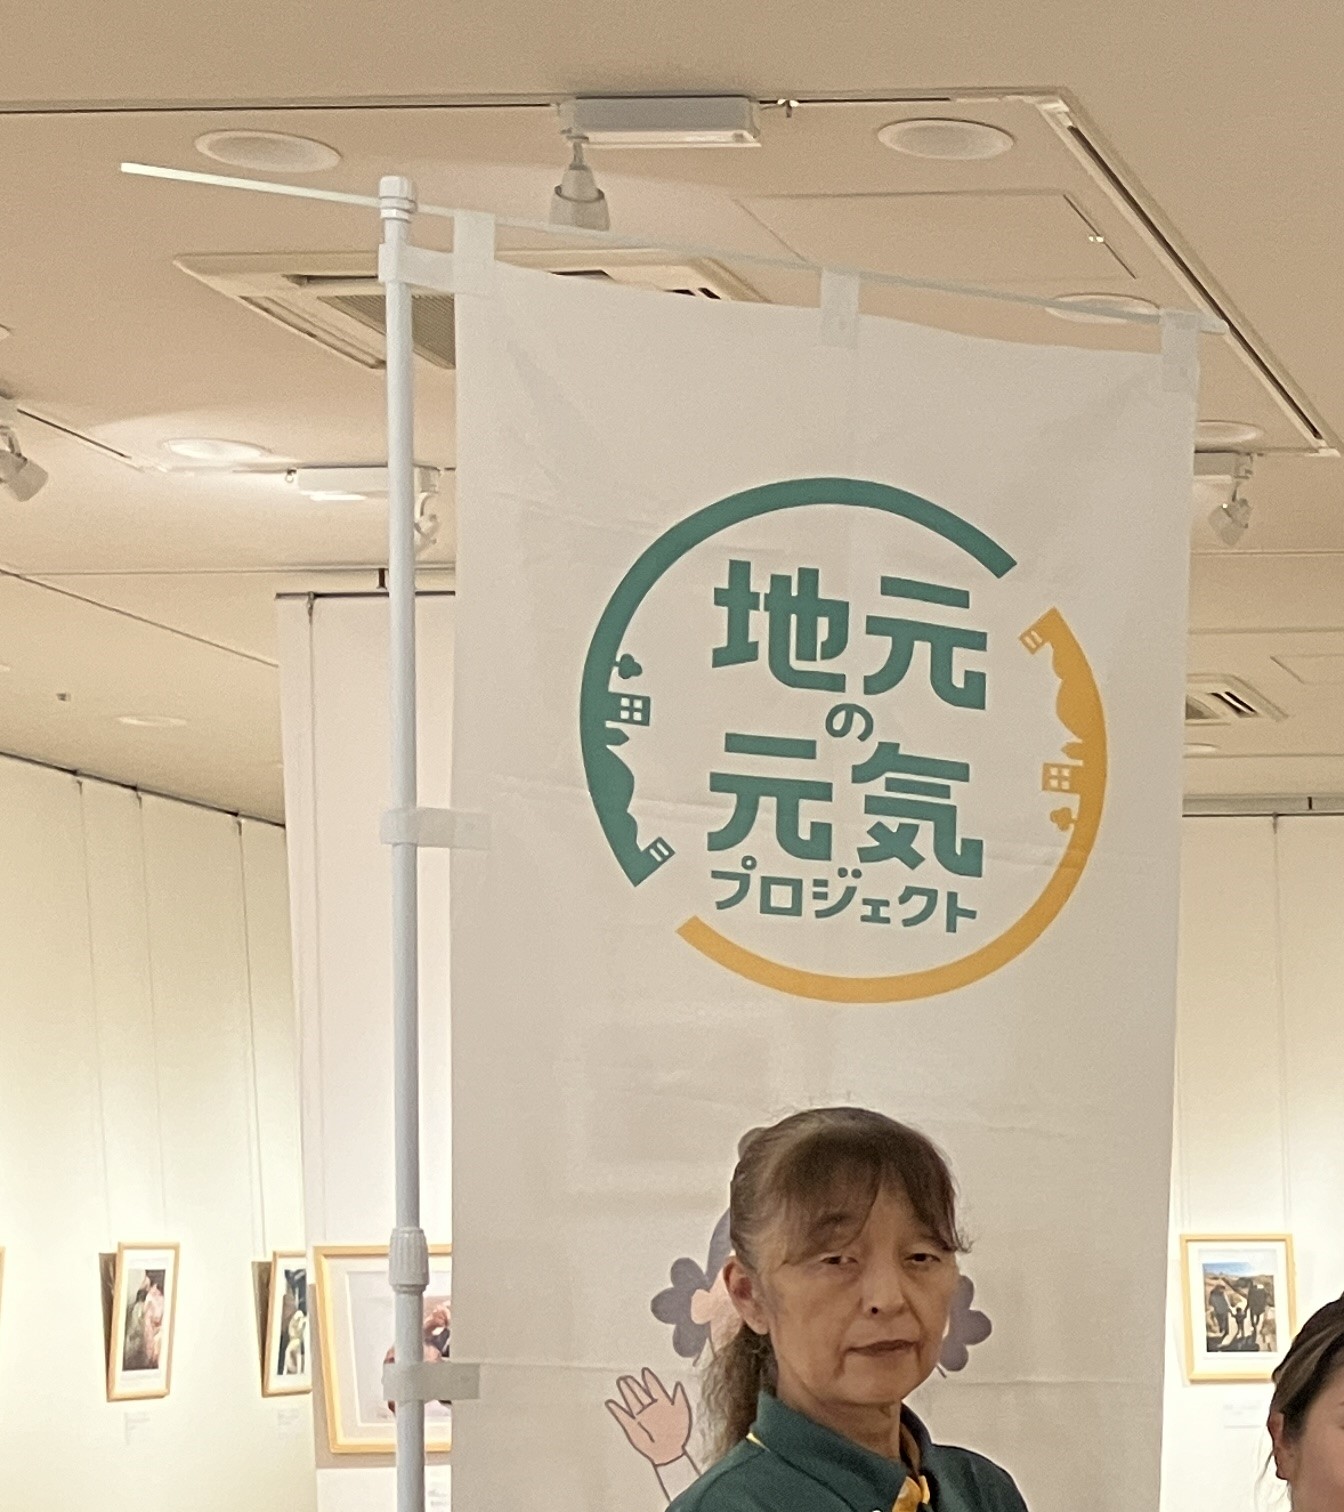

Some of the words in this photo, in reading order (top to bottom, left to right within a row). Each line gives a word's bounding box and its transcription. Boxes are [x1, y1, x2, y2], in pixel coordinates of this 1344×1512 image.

[711, 559, 987, 710] 地元
[824, 702, 874, 742] の
[706, 732, 984, 878] 元気
[710, 855, 978, 934] プロジェクト
